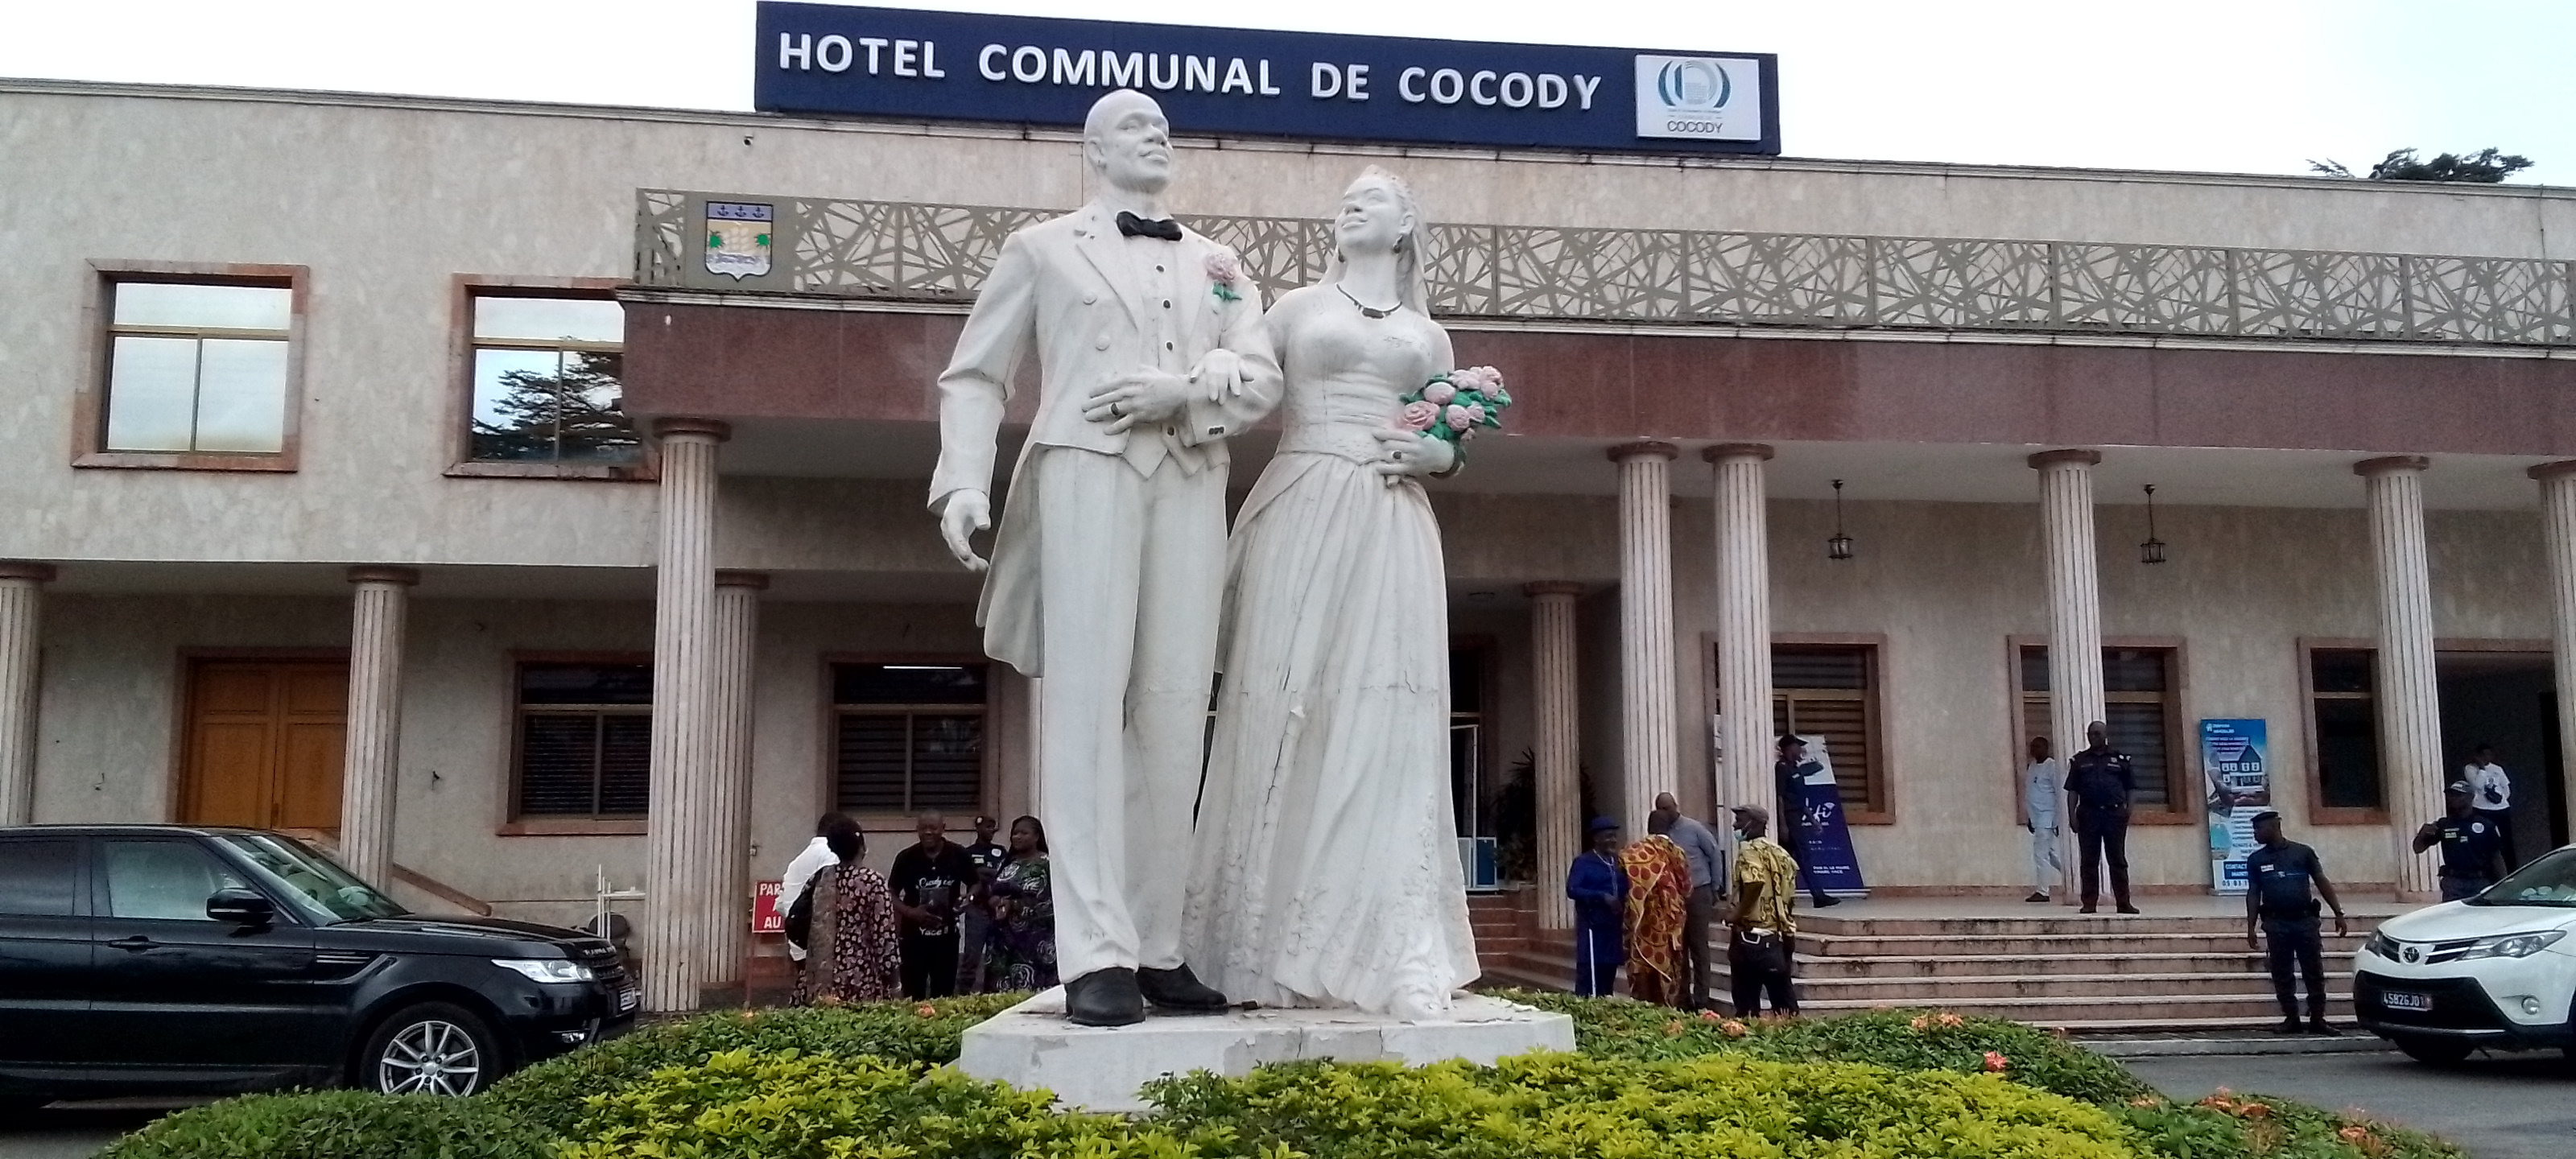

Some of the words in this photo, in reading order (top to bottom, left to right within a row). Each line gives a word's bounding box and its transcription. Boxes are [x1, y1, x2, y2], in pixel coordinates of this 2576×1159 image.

[778, 31, 945, 79] HOTEL
[978, 43, 1281, 96] COMMUNAL
[1311, 62, 1371, 102] DE
[1399, 66, 1602, 110] COCODY
[1667, 120, 1724, 134] COCODY
[759, 883, 782, 896] PAR
[763, 916, 782, 929] AU
